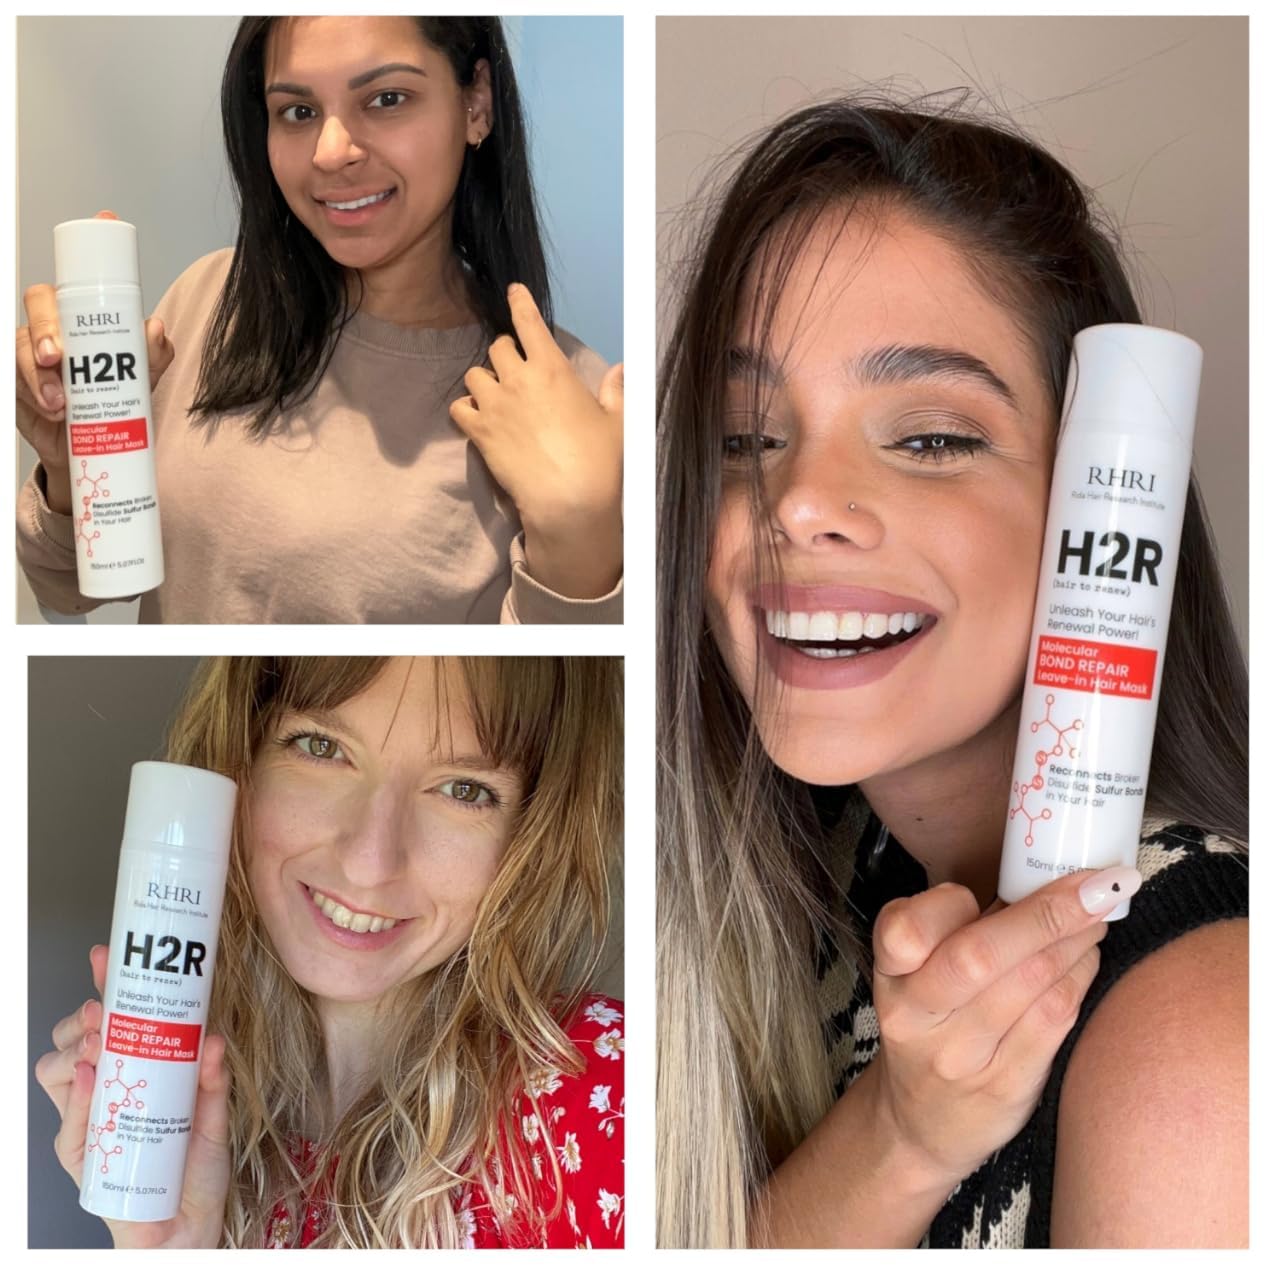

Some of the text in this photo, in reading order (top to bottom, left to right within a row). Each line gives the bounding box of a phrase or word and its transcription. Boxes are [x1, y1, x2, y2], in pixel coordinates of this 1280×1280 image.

[76, 312, 120, 328] RHRI
[70, 352, 137, 384] H2R
[96, 432, 129, 442] REPAIR
[1087, 466, 1155, 492] RHRI
[1057, 529, 1163, 586] H2R
[1049, 604, 1156, 628] Unleash Your Hair's
[1048, 618, 1139, 641] Renewal Power!
[1042, 640, 1098, 657] Molecular
[1039, 655, 1129, 678] BOND REPAIR
[1095, 785, 1123, 796] Sulfur
[147, 882, 201, 905] RHRI
[123, 931, 207, 976] H2R
[156, 996, 179, 1006] Your
[112, 1018, 158, 1033] Molecular
[110, 1029, 181, 1047] BOND REPAIR
[151, 1047, 194, 1058] Hair Mask
